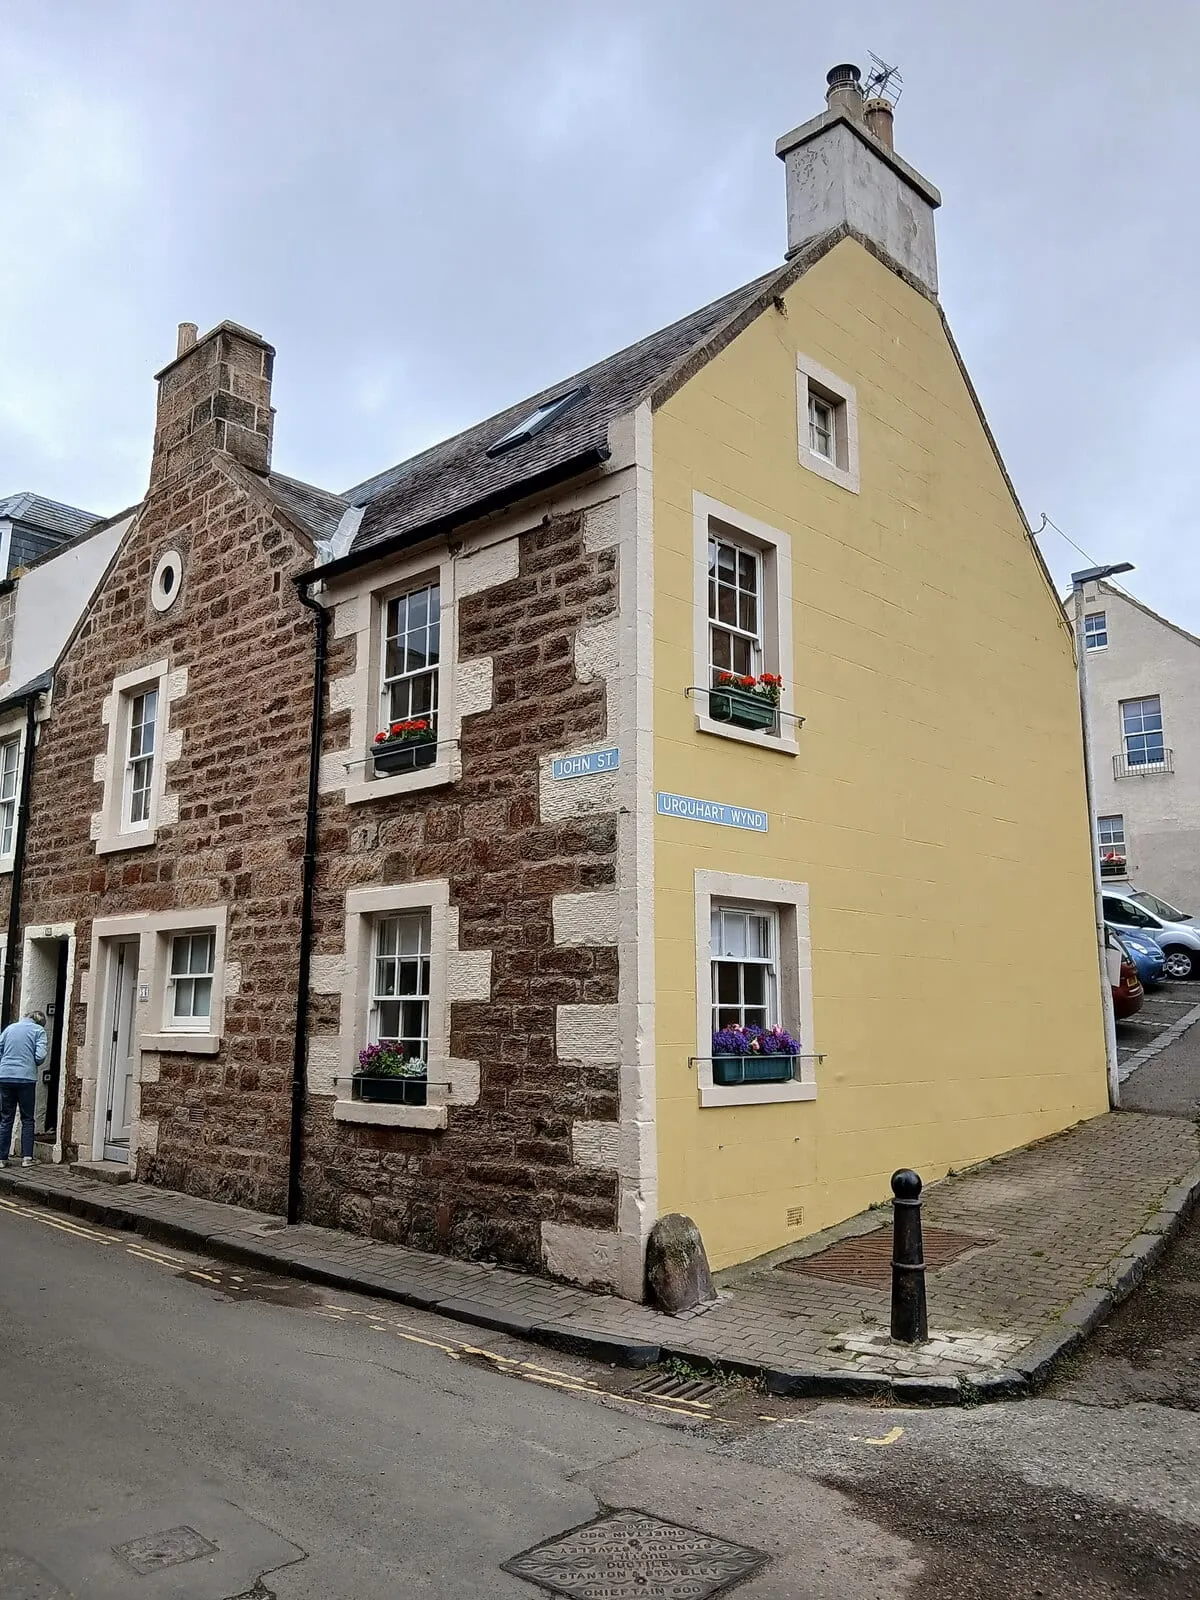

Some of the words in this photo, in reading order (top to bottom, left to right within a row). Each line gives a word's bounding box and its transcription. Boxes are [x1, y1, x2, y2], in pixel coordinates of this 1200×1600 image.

[559, 757, 590, 776] JOHN
[597, 752, 614, 768] ST.
[663, 796, 725, 820] URQUHART
[731, 809, 762, 827] WYND
[560, 1546, 631, 1554] STAVELEY
[648, 1543, 712, 1551] STANTON
[607, 1561, 670, 1569] DUCTILE
[559, 1570, 626, 1580] STANTON
[645, 1568, 719, 1577] STAVELEY
[584, 1587, 665, 1597] CHIEFTAIN
